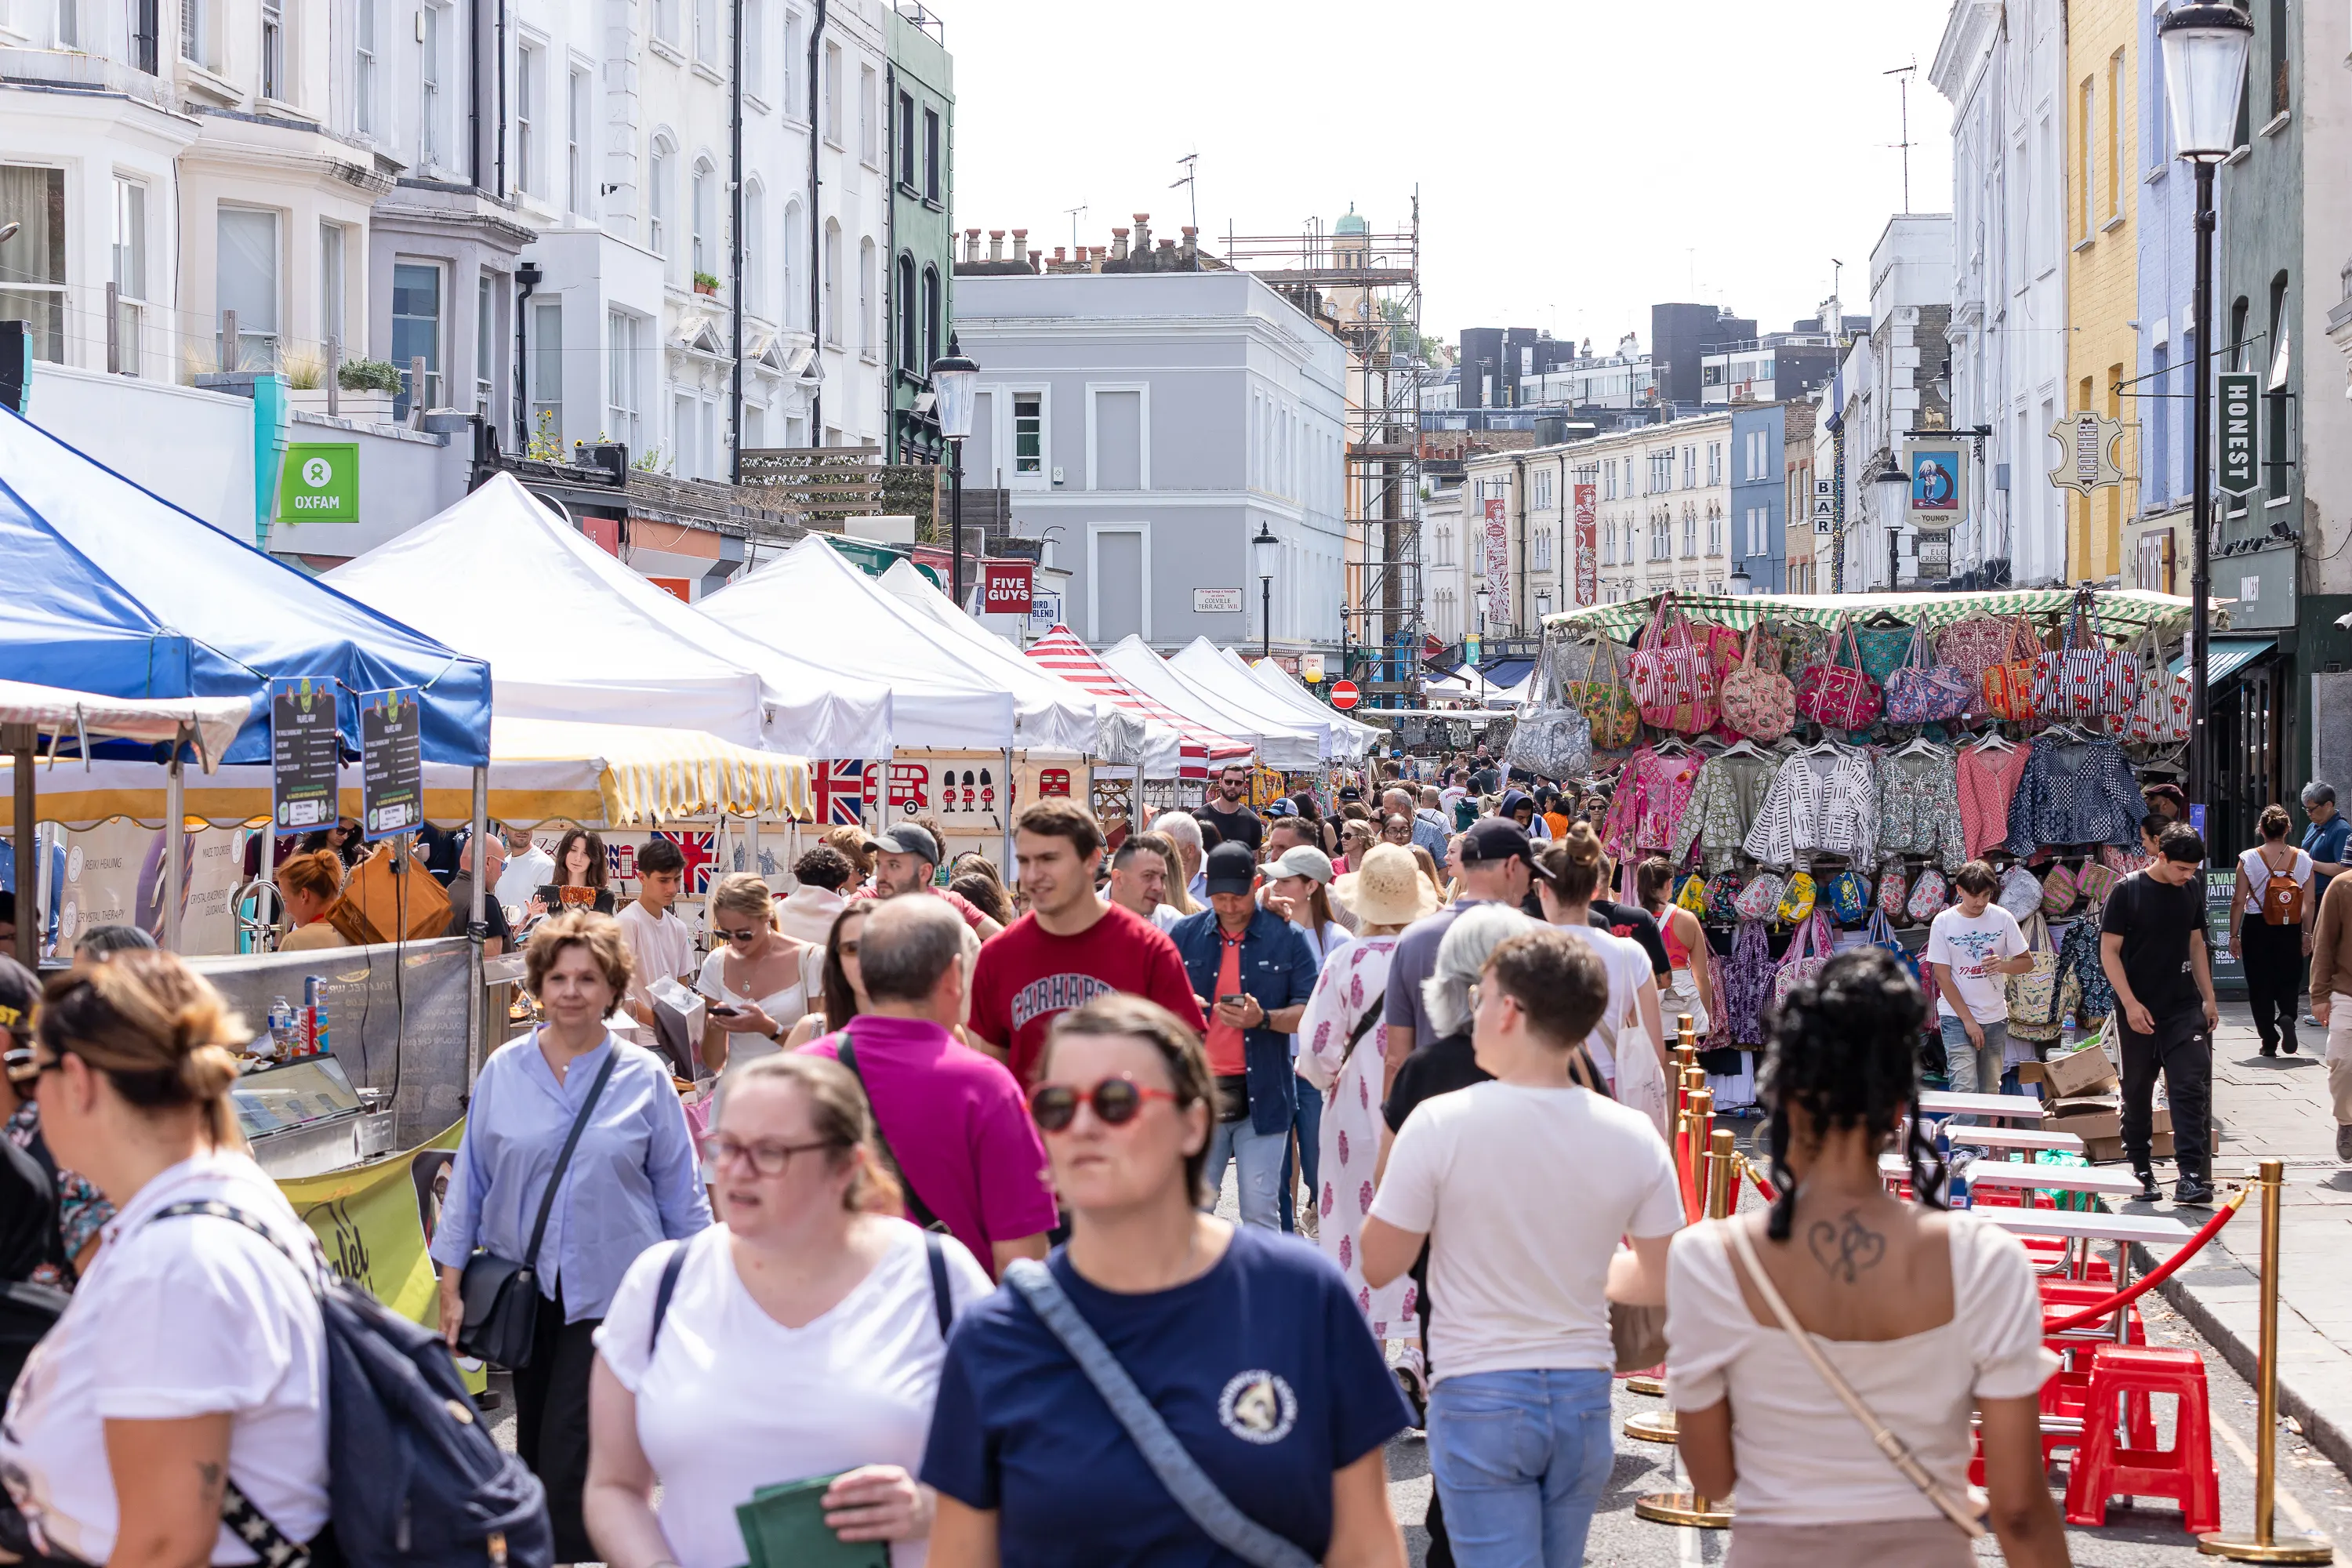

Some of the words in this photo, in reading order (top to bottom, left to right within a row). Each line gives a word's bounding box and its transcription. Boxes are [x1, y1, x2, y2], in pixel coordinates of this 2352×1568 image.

[2227, 385, 2249, 479] HONEST
[2078, 423, 2098, 481] LEATHER
[295, 495, 339, 509] OXFAM
[1817, 482, 1830, 532] BAR
[992, 578, 1025, 589] FIVE
[2241, 575, 2259, 602] HONEST
[988, 590, 1029, 601] GUYS
[1032, 609, 1054, 618] BLEND
[220, 844, 231, 855] ORDER
[85, 859, 100, 870] REIKI
[100, 857, 122, 869] HEALING
[2207, 885, 2236, 896] AITIN
[191, 892, 207, 905] CRYSTAL
[77, 911, 102, 923] CRYSTAL
[102, 909, 125, 920] THERAPY
[205, 904, 226, 916] GUIDANCE
[1011, 972, 1120, 1031] CARHART
